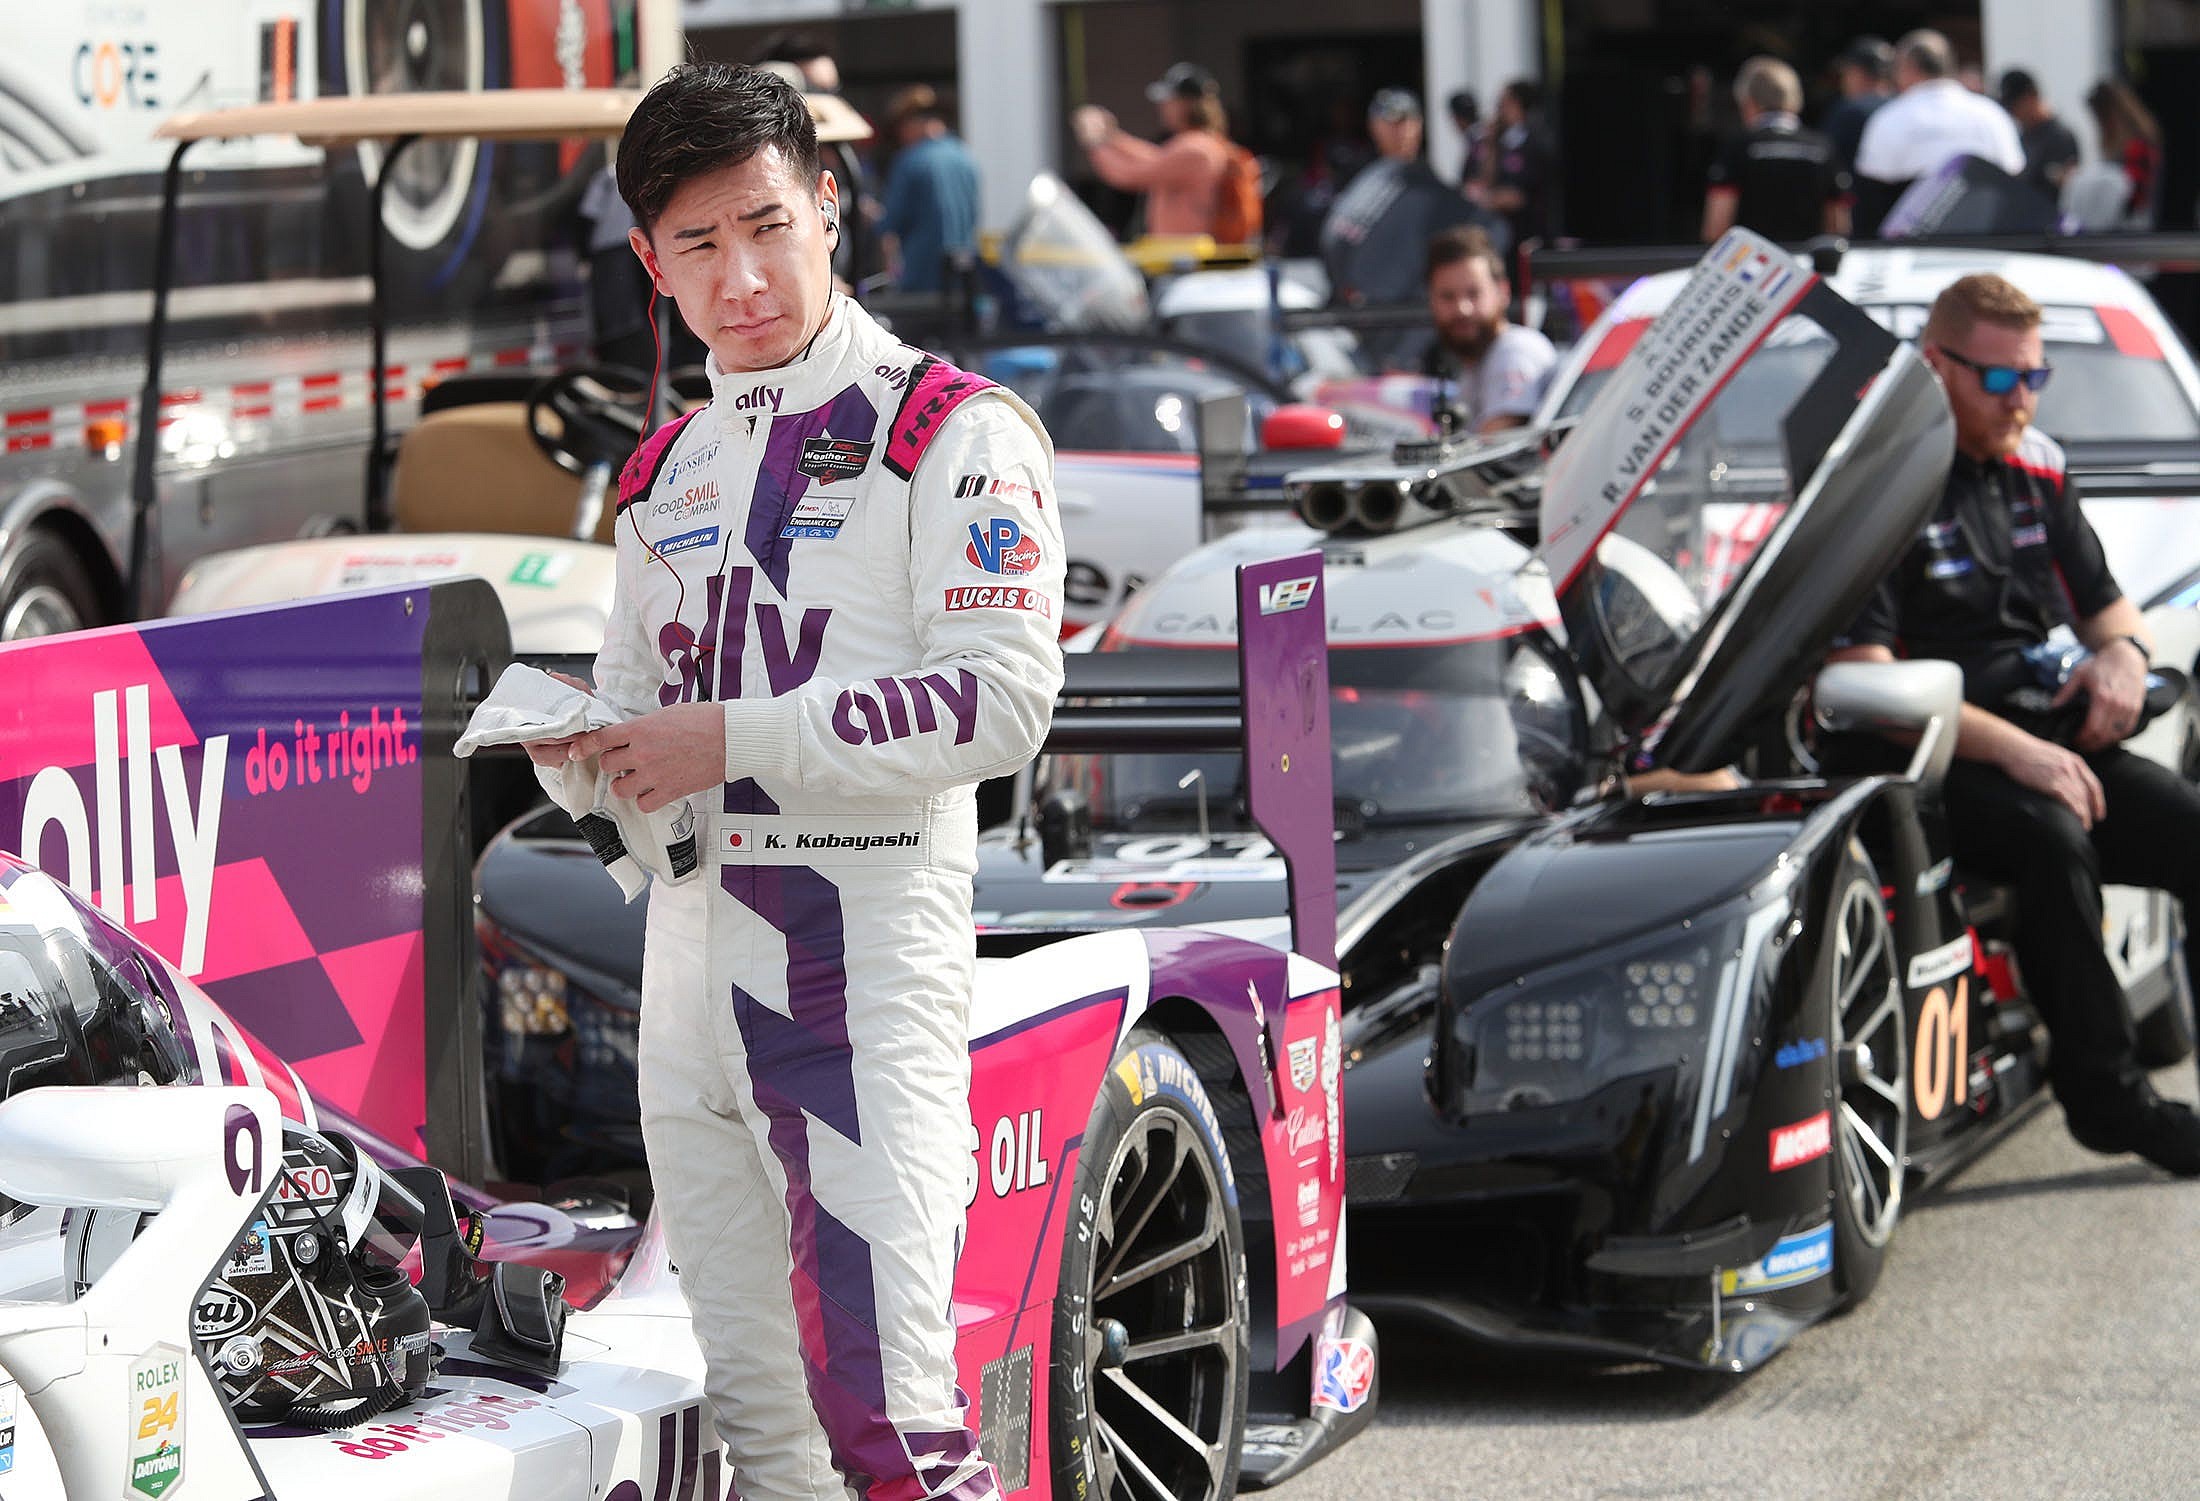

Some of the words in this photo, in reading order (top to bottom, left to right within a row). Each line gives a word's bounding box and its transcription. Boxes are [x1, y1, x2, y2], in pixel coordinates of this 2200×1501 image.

[1646, 285, 1742, 399] BOURDAIS
[875, 365, 910, 391] ally
[1620, 427, 1662, 476] VAN
[1658, 376, 1701, 424] DER
[1700, 299, 1768, 374] ZANDE
[735, 385, 784, 412] ally
[684, 480, 719, 508] SMIL
[659, 533, 713, 553] MICHELIN
[968, 518, 1020, 575] VP
[1003, 550, 1041, 568] Racing
[949, 587, 1020, 610] LUCAS
[1024, 590, 1050, 615] OIL
[832, 668, 978, 746] ally
[245, 727, 289, 796] do
[295, 717, 322, 784] it
[327, 707, 417, 794] right.
[765, 834, 787, 849] K.
[796, 832, 920, 851] Kobayashi
[1914, 974, 1968, 1120] 01
[1158, 1053, 1235, 1188] MICHELIN
[990, 1108, 1048, 1198] OIL
[328, 1347, 356, 1359] GOOD
[136, 1361, 179, 1392] ROLEX
[137, 1391, 179, 1440] 24
[413, 1395, 542, 1433] right.
[367, 1423, 446, 1444] it
[332, 1437, 409, 1460] do
[135, 1453, 179, 1480] DAYTONA
